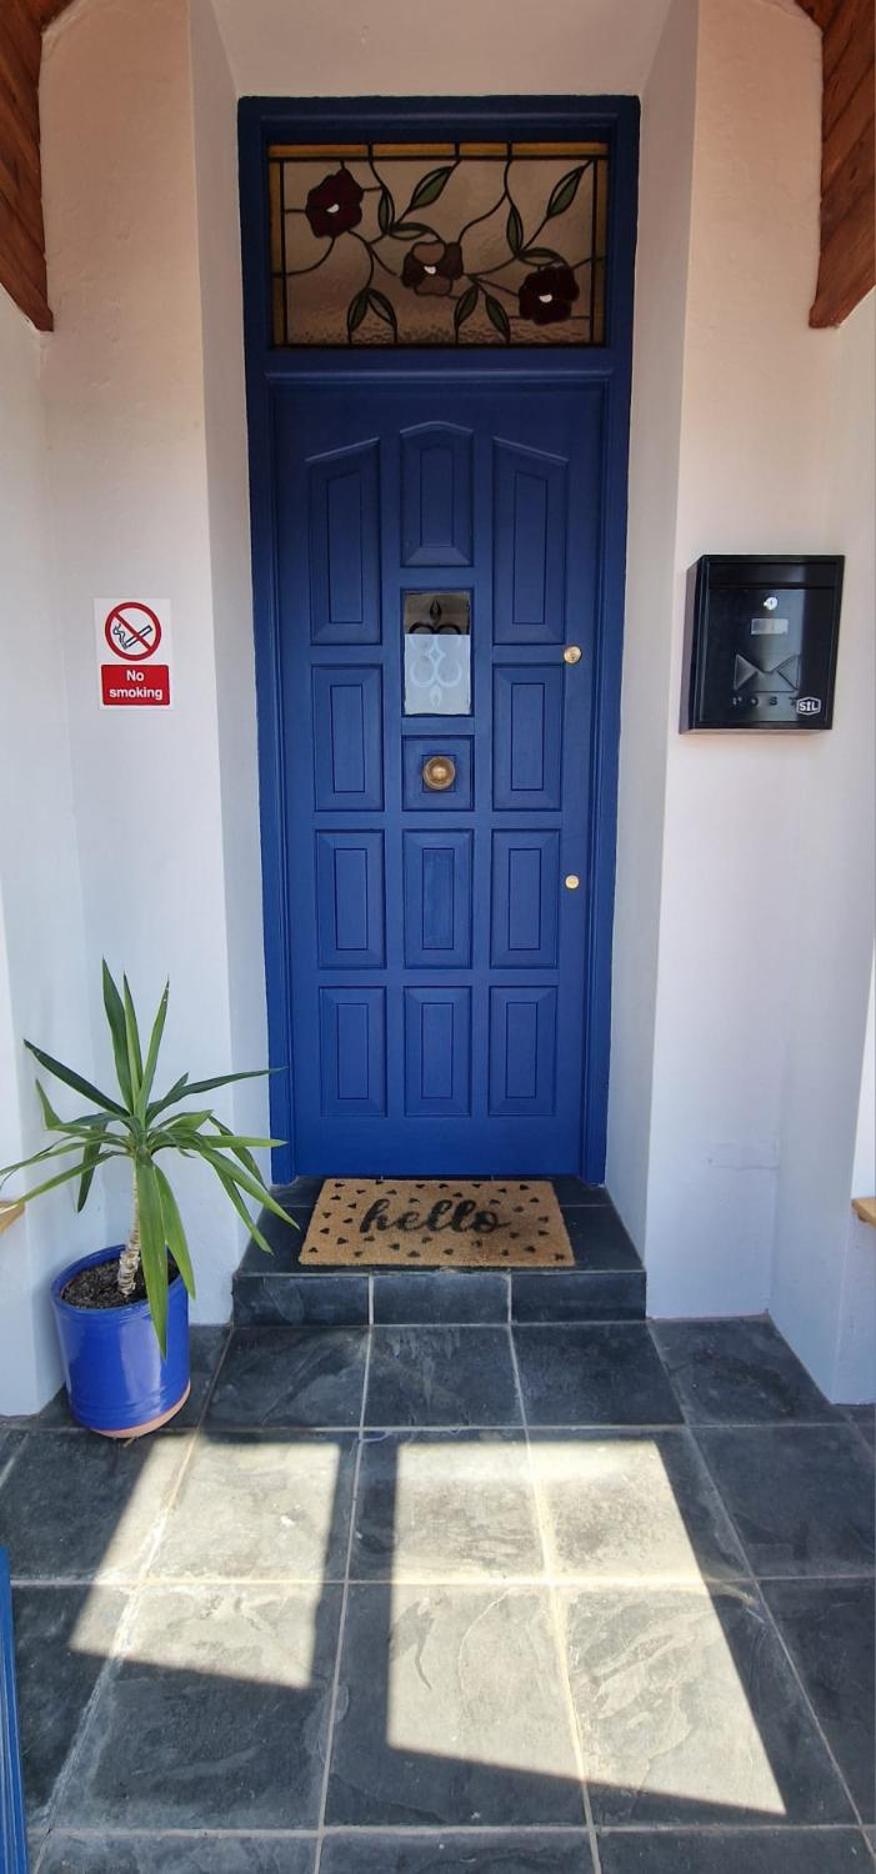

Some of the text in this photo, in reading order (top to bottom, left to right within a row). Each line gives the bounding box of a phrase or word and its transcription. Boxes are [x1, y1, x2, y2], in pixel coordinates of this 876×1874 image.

[126, 670, 145, 682] No
[109, 687, 163, 701] smoking
[799, 701, 819, 713] SIL
[359, 1199, 512, 1233] hello
